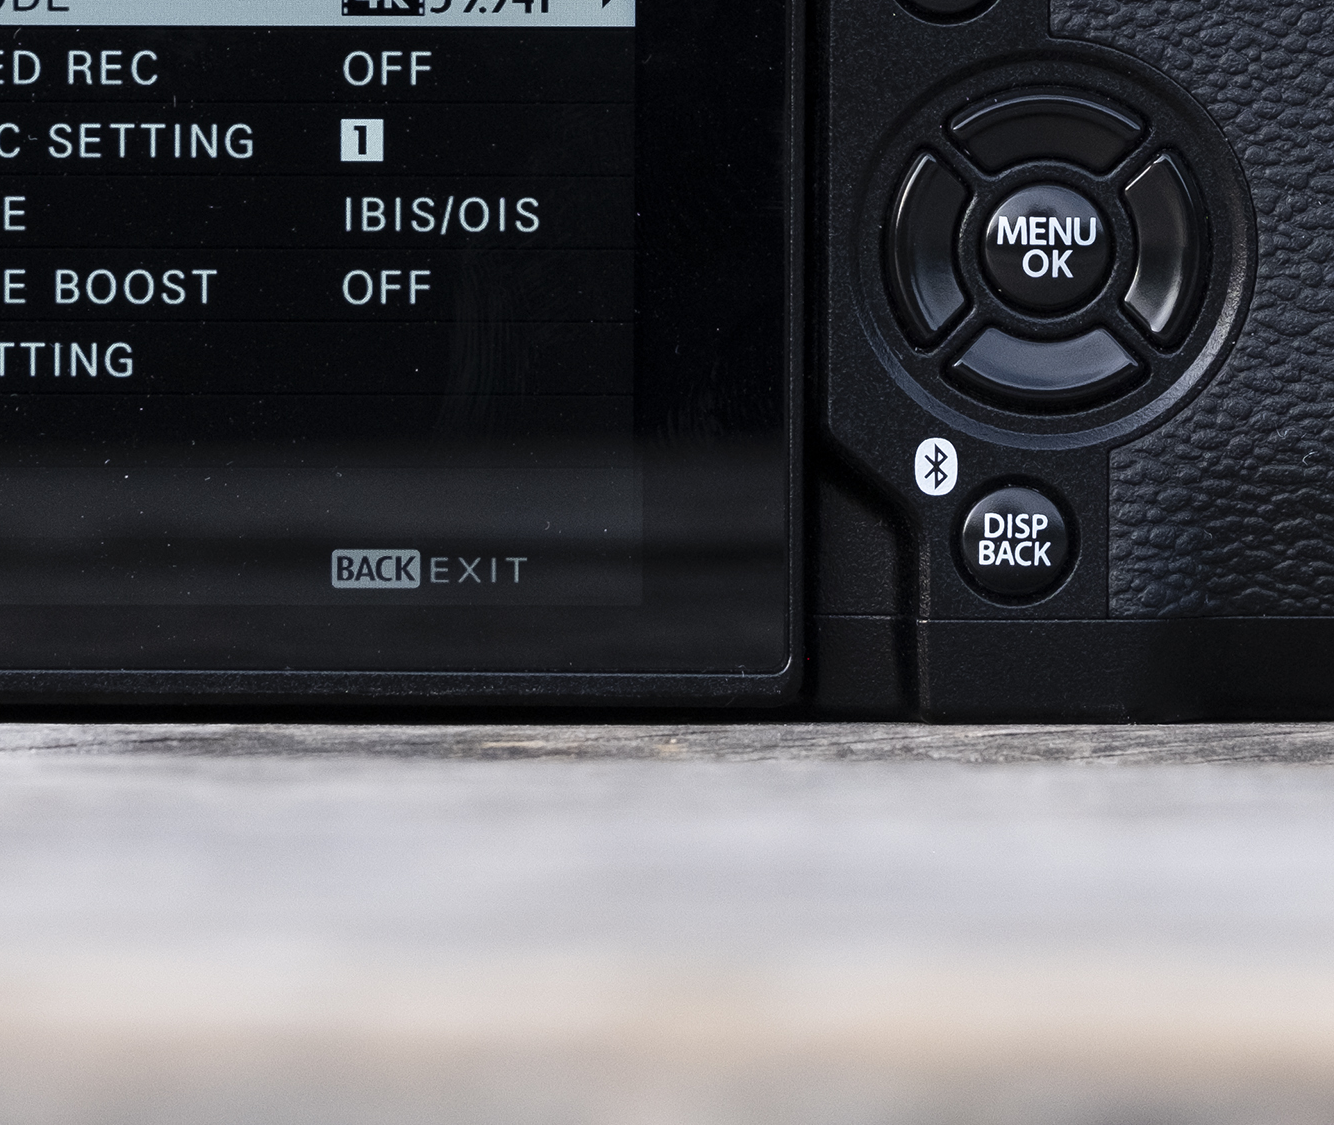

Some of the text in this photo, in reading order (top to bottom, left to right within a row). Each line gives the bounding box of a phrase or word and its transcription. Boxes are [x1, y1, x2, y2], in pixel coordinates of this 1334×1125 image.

[67, 49, 158, 86] REC
[342, 50, 432, 86] OFF
[48, 123, 253, 159] SETTING
[353, 125, 367, 156] 1
[345, 195, 540, 235] IBIS/OIS
[996, 215, 1097, 246] MENU
[1022, 248, 1074, 278] OK
[55, 268, 218, 305] BOOST
[342, 269, 431, 305] OFF
[983, 512, 1049, 540] DISP
[336, 555, 528, 584] BACK EXIT
[978, 540, 1051, 567] BACK
